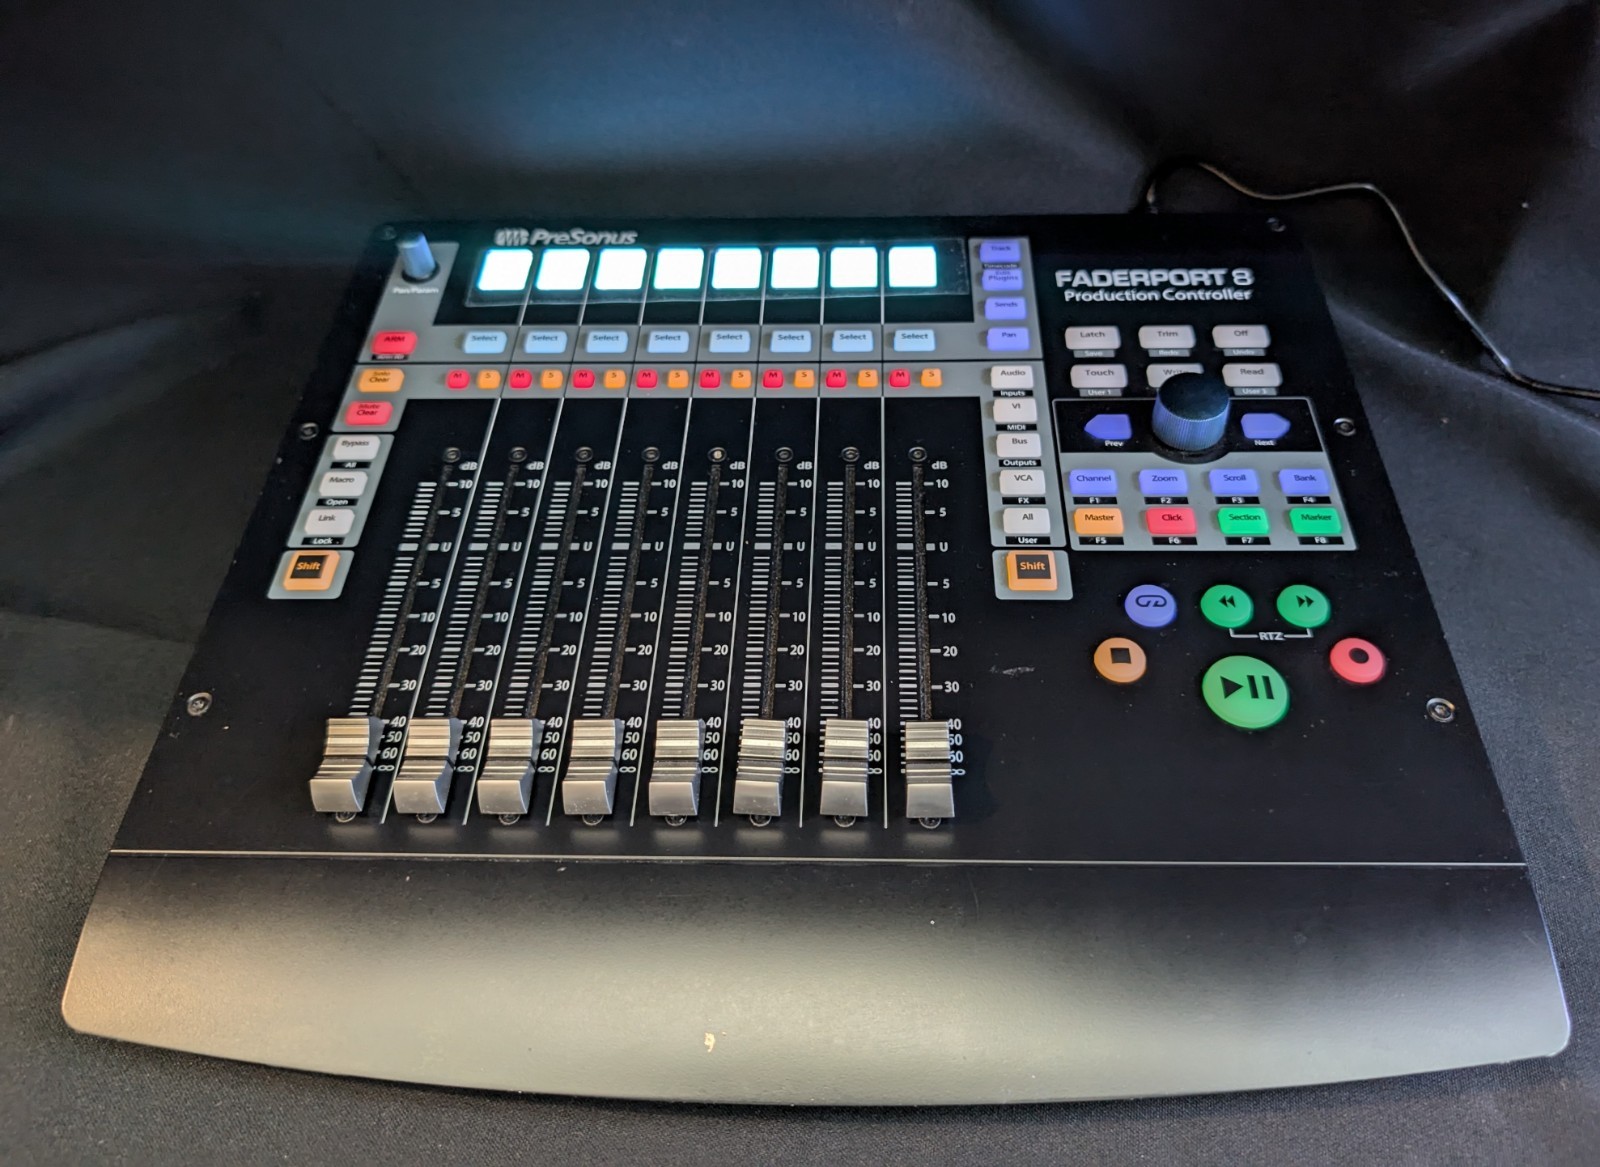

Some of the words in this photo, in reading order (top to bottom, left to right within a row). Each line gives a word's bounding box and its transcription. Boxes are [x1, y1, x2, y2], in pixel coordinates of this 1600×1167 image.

[530, 230, 638, 246] PreSonus
[1055, 269, 1228, 287] FADERPORT
[1232, 268, 1254, 286] 8
[1064, 289, 1160, 301] Production
[1162, 289, 1253, 300] Controller
[459, 462, 477, 470] dB
[526, 462, 544, 470] dB
[594, 462, 611, 470] dB
[662, 462, 678, 470] dB
[730, 462, 745, 470] dB
[797, 462, 812, 470] dB
[864, 462, 879, 470] dB
[932, 462, 947, 470] dB
[1294, 474, 1316, 482] Bank
[459, 480, 473, 488] 10
[526, 480, 540, 488] 10
[593, 480, 607, 488] 10
[664, 479, 676, 488] 10
[732, 479, 744, 488] 10
[800, 479, 812, 488] 10
[867, 479, 880, 488] 10
[936, 479, 949, 488] 10
[800, 508, 807, 516] 5
[869, 508, 876, 516] 5
[939, 508, 946, 517] 5
[1162, 514, 1182, 522] Click
[441, 542, 451, 551] U
[512, 542, 521, 551] U
[583, 542, 593, 551] U
[654, 542, 664, 551] U
[726, 542, 734, 551] U
[797, 542, 805, 551] U
[868, 542, 876, 551] U
[939, 542, 948, 551] U
[1020, 562, 1046, 570] Shift
[420, 612, 435, 622] 10
[494, 612, 508, 622] 10
[569, 612, 582, 622] 10
[644, 612, 657, 622] 10
[718, 612, 731, 622] 10
[793, 612, 806, 622] 10
[867, 612, 880, 622] 10
[941, 613, 955, 623] 10
[1259, 632, 1285, 640] RTZ
[411, 645, 426, 655] 20
[484, 645, 501, 655] 20
[561, 645, 576, 655] 20
[637, 645, 652, 655] 20
[714, 645, 728, 655] 20
[790, 645, 804, 655] 20
[866, 645, 880, 656] 20
[943, 646, 957, 656] 20
[400, 680, 416, 690] 30
[476, 680, 492, 690] 30
[554, 680, 569, 690] 30
[632, 680, 647, 691] 30
[710, 681, 725, 691] 30
[787, 681, 802, 691] 30
[866, 681, 881, 691] 30
[944, 682, 959, 692] 30
[389, 716, 406, 728] 40
[468, 716, 484, 728] 40
[547, 717, 563, 728] 40
[627, 717, 642, 728] 40
[706, 717, 722, 728] 40
[787, 717, 801, 728] 40
[385, 731, 402, 743] 50
[464, 732, 481, 743] 50
[544, 732, 560, 743] 50
[624, 732, 639, 743] 50
[705, 732, 720, 744] 50
[382, 747, 398, 759] 60
[461, 748, 477, 759] 60
[541, 749, 557, 760] 60
[621, 749, 638, 760] 60
[703, 749, 718, 760] 60
[785, 749, 799, 761] 60
